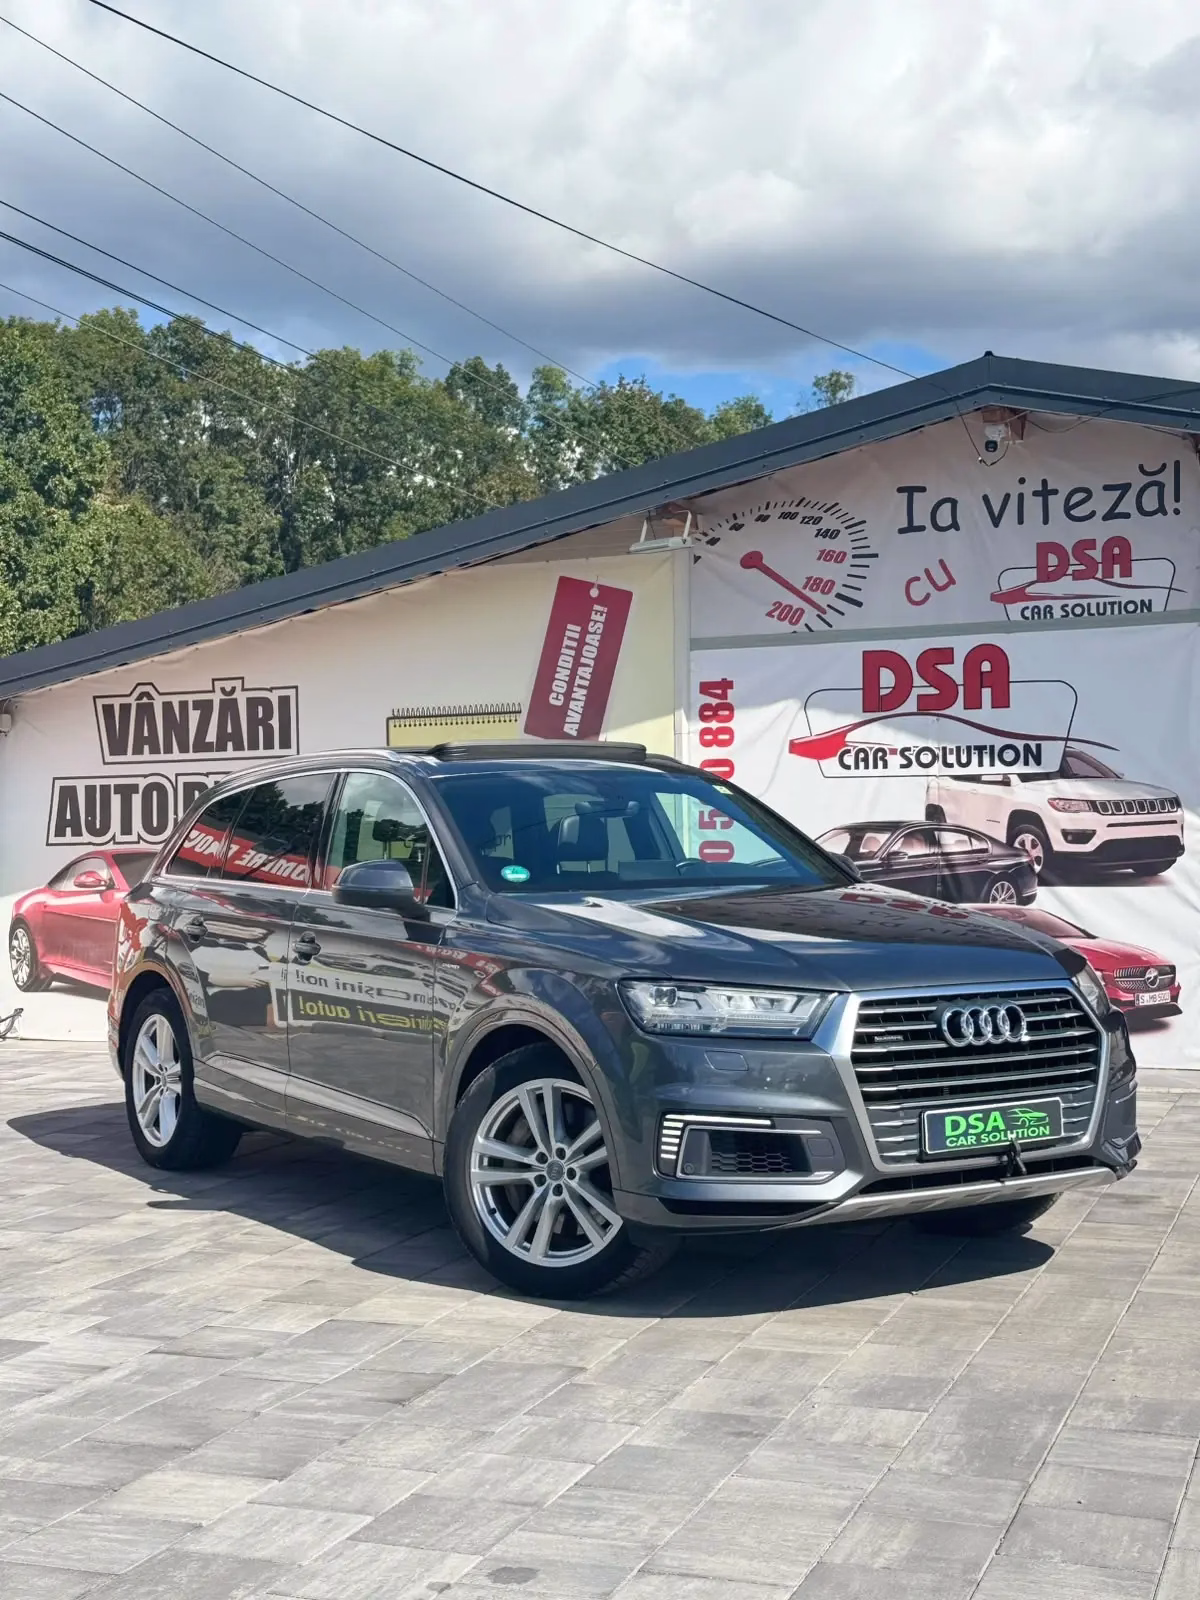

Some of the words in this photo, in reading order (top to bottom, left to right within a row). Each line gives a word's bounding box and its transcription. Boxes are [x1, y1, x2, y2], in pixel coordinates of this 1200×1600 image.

[896, 485, 961, 535] Ia
[982, 460, 1181, 529] viteză!
[777, 511, 799, 521] 100
[799, 515, 823, 526] 120
[814, 528, 841, 540] 140
[816, 549, 847, 564] 160
[1036, 535, 1132, 583] DSA
[802, 575, 836, 595] 180
[905, 558, 956, 607] cu
[765, 600, 805, 626] 200
[1020, 603, 1054, 621] CAR
[1060, 599, 1153, 619] SOLUTION
[549, 623, 582, 707] CONDITII
[563, 604, 608, 737] AVANTAJOASE!
[862, 643, 1011, 713] DSA
[102, 686, 292, 757] VÂNZĂRI
[838, 747, 888, 771] CAR
[899, 743, 1042, 769] SOLUTION
[54, 781, 169, 838] AUTO
[944, 1111, 1006, 1136] DSA
[946, 1134, 977, 1147] CAR
